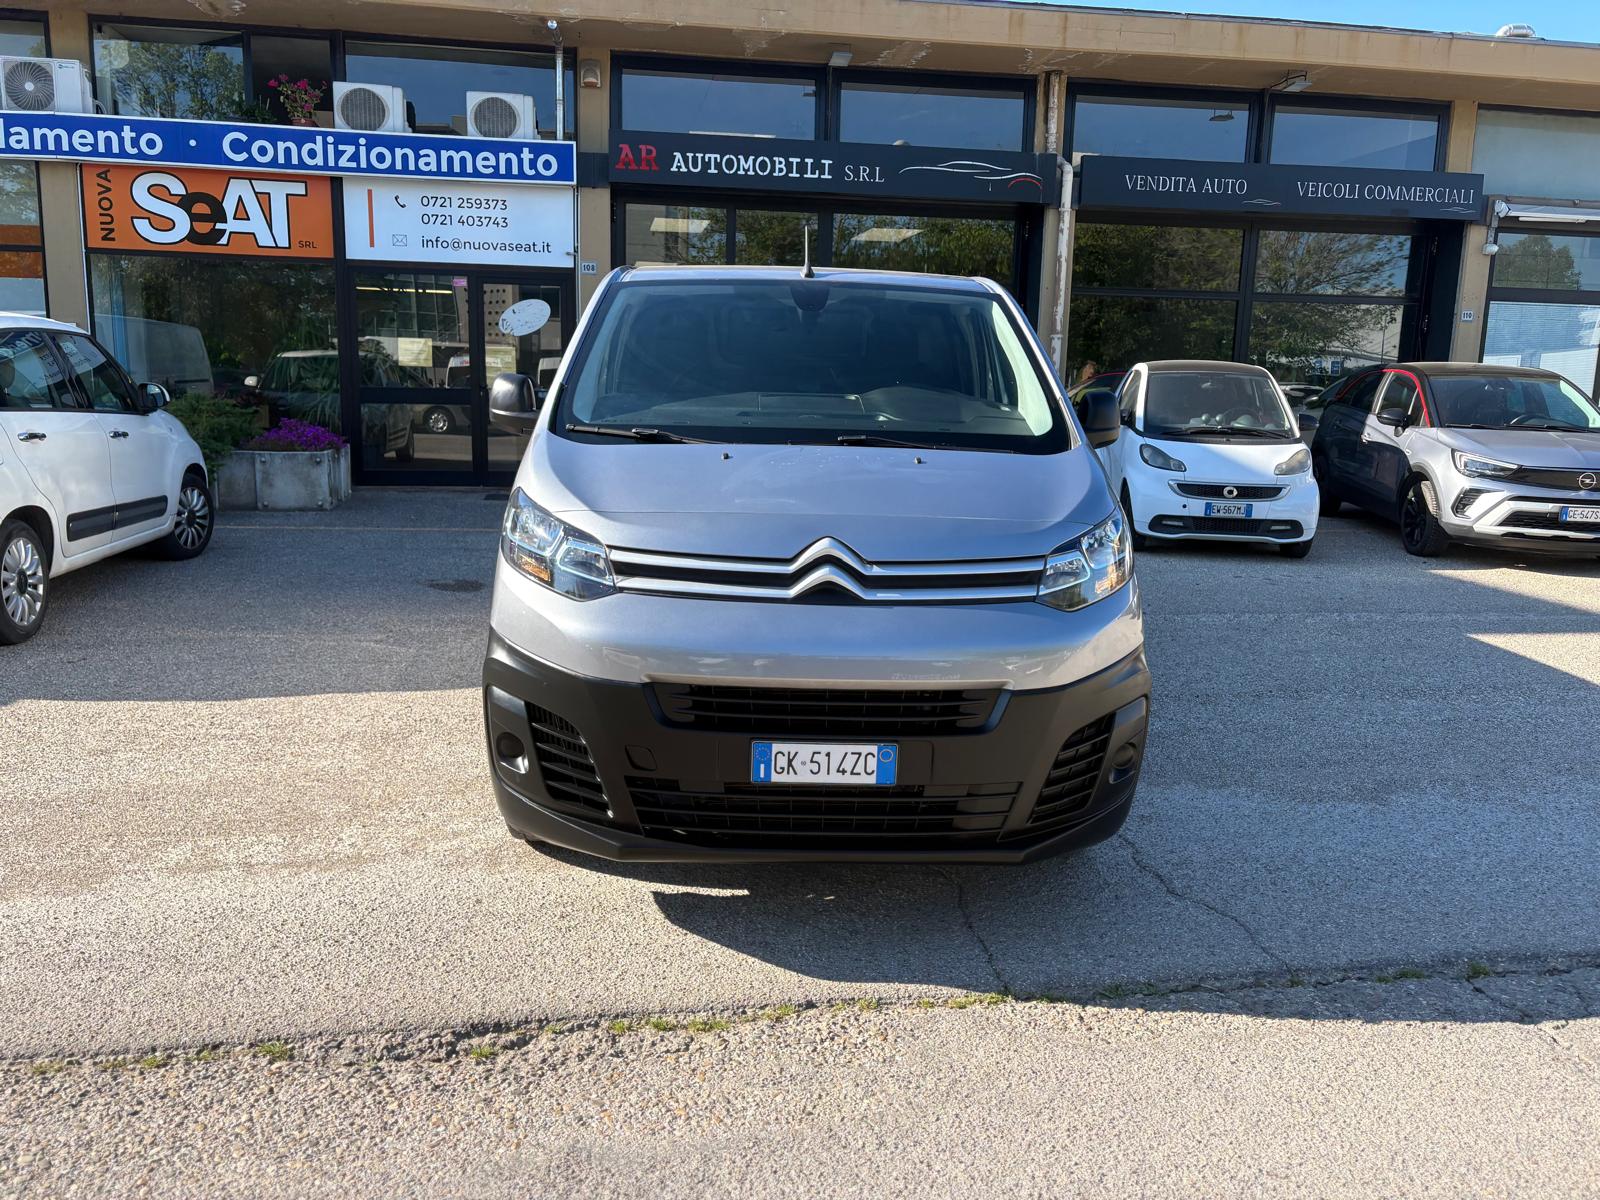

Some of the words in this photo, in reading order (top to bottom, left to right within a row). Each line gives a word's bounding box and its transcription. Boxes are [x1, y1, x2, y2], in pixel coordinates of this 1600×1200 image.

[0, 118, 163, 156] lamento
[222, 131, 558, 177] Condizionamento
[615, 143, 659, 171] AR
[670, 152, 833, 179] AUTOMOBILI
[844, 165, 885, 183] S.R.L
[1124, 174, 1197, 193] VENDITA
[1202, 178, 1247, 194] AUTO
[1297, 181, 1360, 199] VEICOLI
[1364, 184, 1474, 204] COMMERCIALI
[96, 168, 116, 242] NUOVA
[421, 195, 452, 208] 0721
[457, 197, 508, 211] 259373
[421, 213, 453, 226] 0721
[457, 215, 508, 228] 403743
[298, 240, 317, 249] SRL
[421, 235, 552, 253] info@nuovaseat.it
